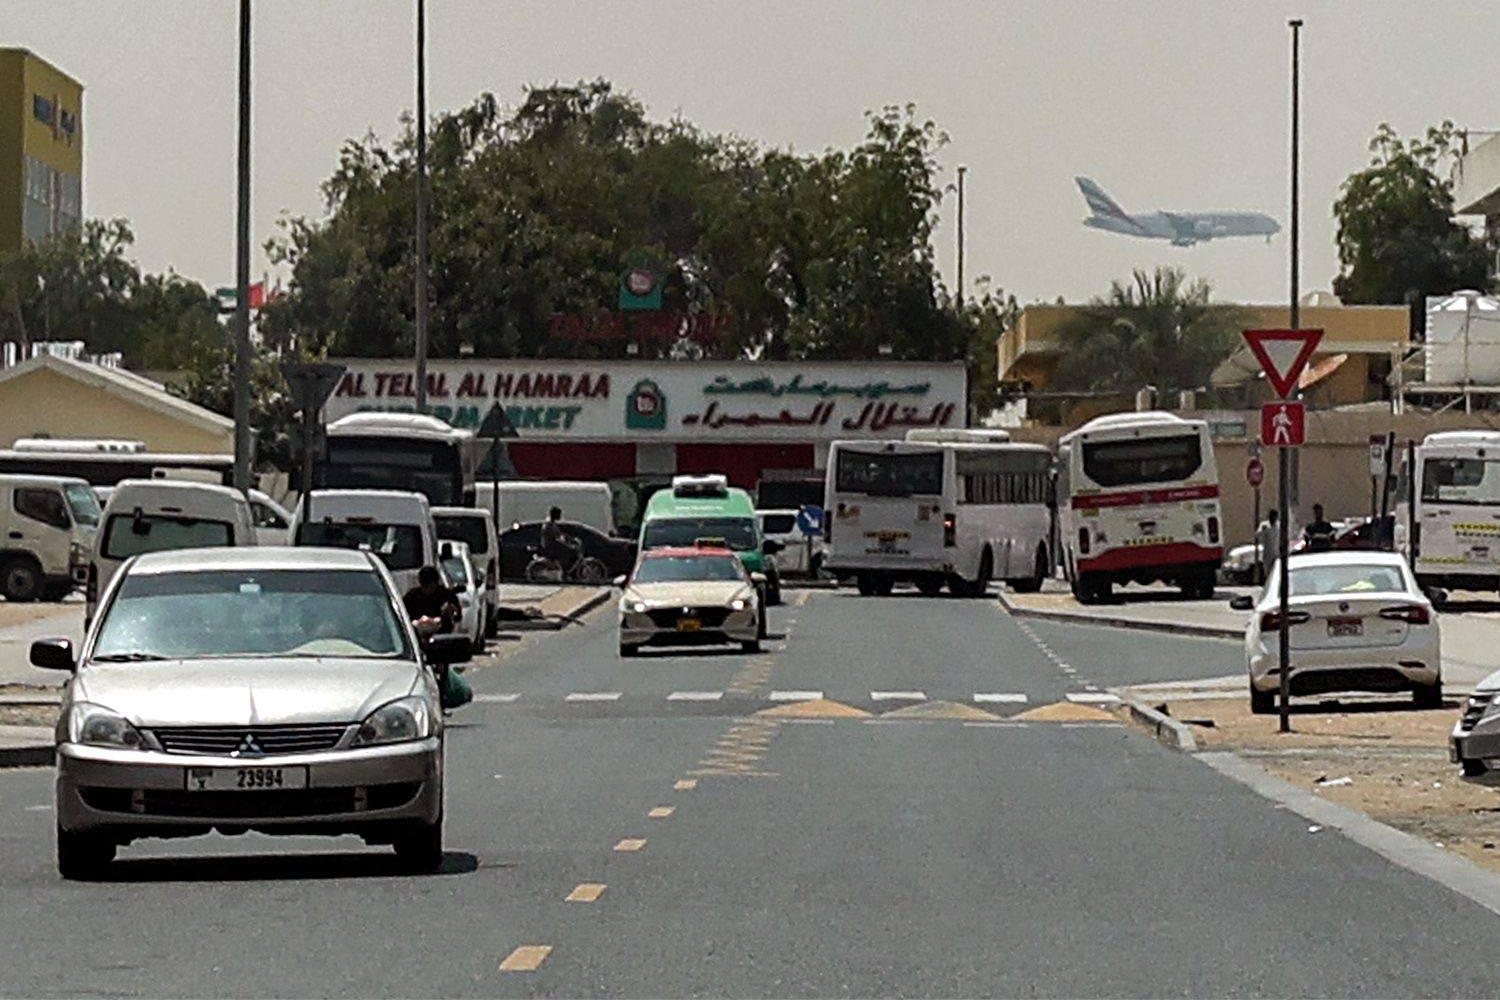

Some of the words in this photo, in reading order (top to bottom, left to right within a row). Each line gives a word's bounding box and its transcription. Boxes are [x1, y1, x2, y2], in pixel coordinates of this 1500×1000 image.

[335, 373, 367, 397] AL
[456, 373, 487, 397] AL
[493, 373, 611, 398] HAMRAA
[237, 769, 284, 788] 23994
